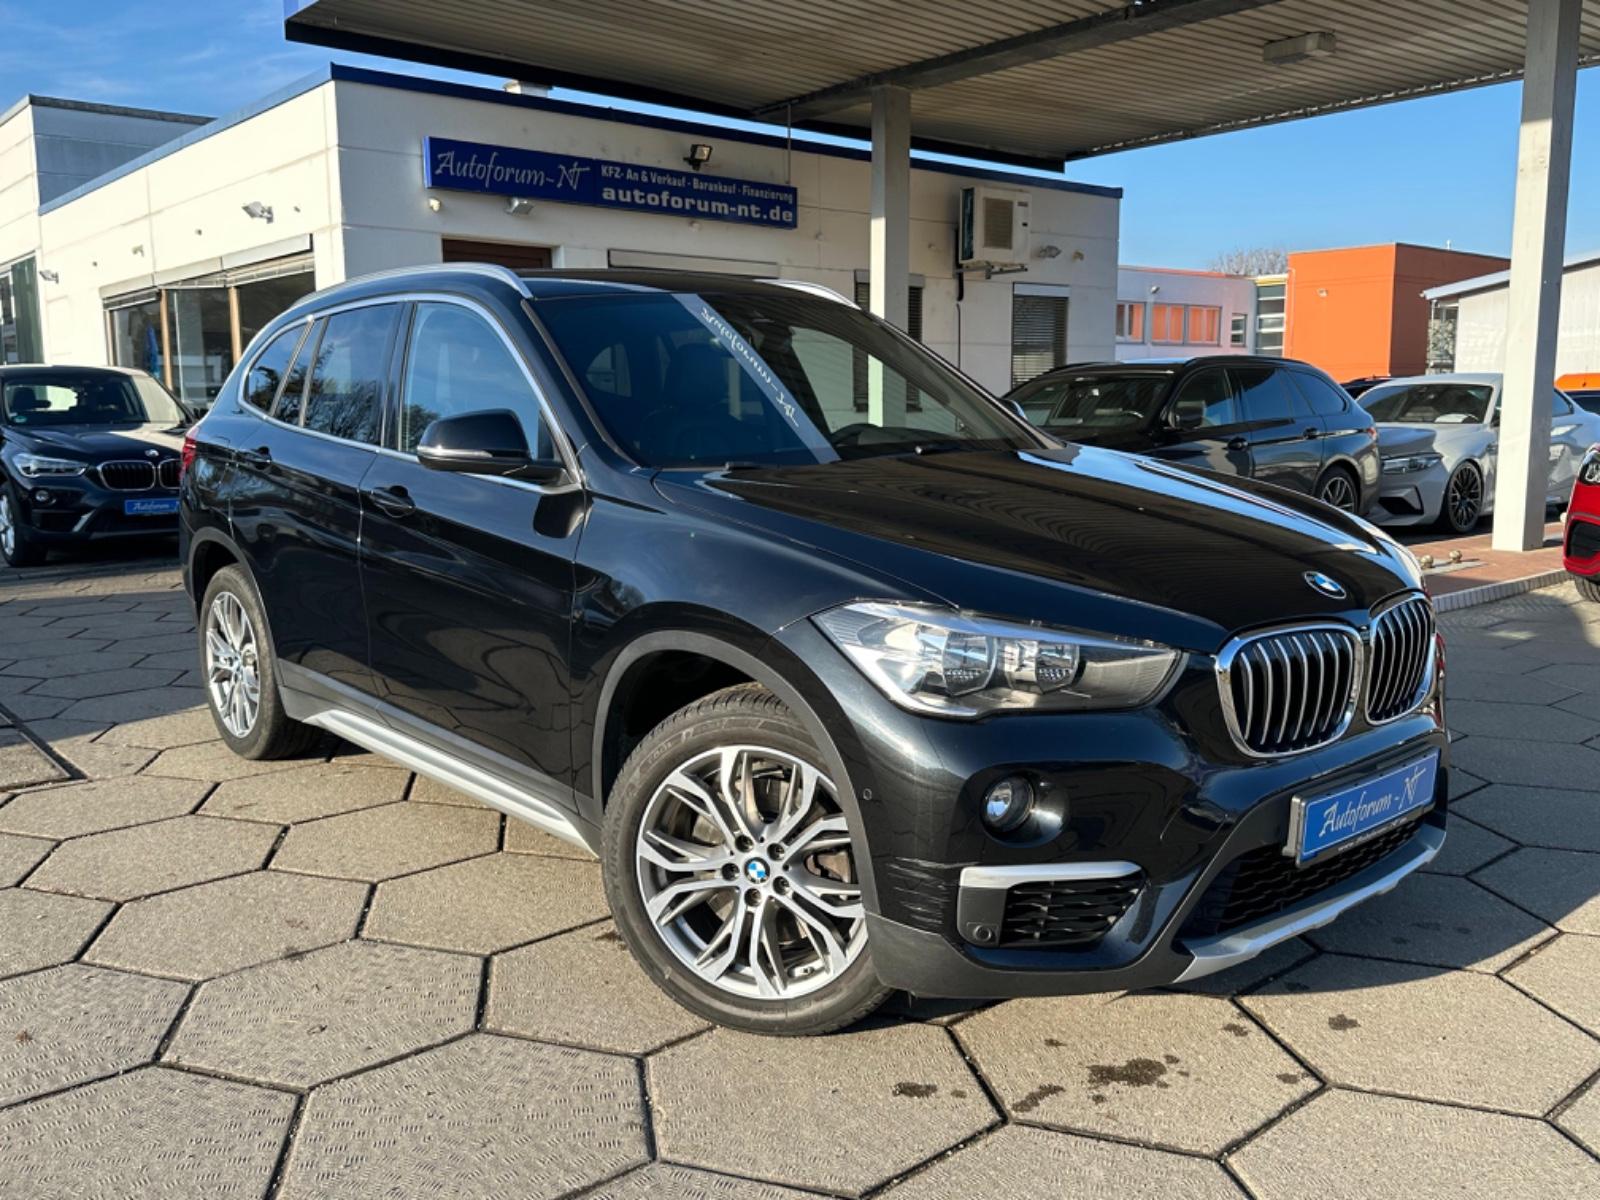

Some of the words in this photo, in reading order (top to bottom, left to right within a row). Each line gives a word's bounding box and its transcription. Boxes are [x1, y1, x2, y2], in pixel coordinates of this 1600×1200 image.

[435, 151, 591, 190] Autoforum-NT
[626, 168, 639, 182] An
[641, 170, 649, 183] &
[650, 171, 686, 188] Verkauf
[742, 184, 793, 205] Finanzierung
[602, 187, 793, 222] autoforum-nt.de
[1319, 766, 1426, 837] Autoforum-NT
